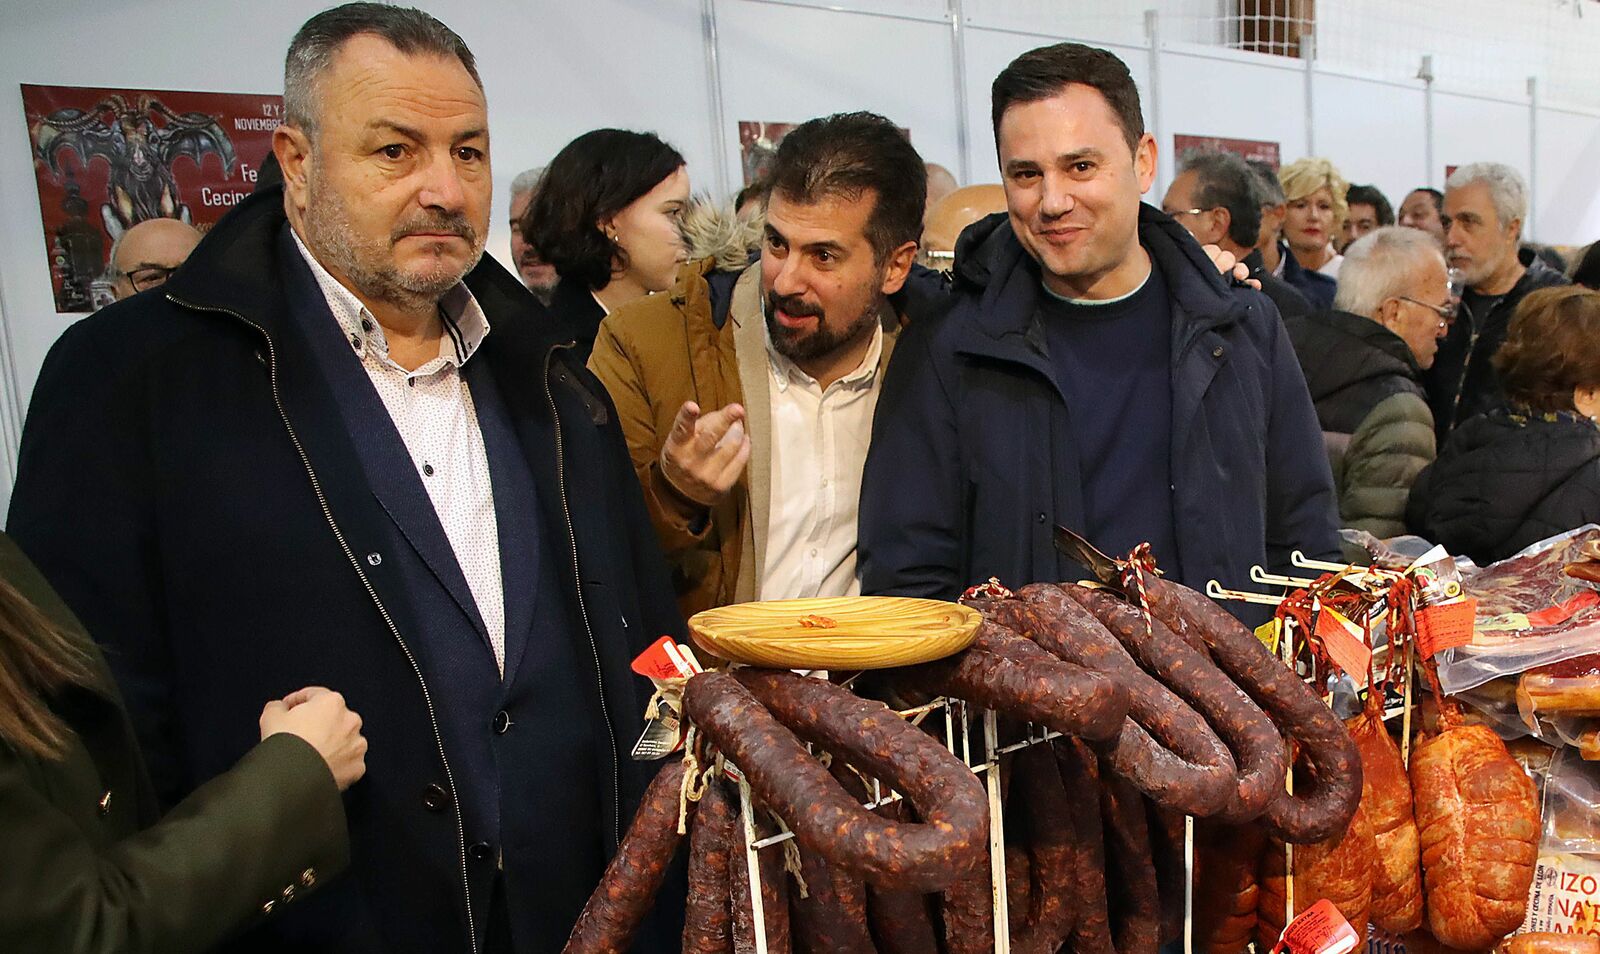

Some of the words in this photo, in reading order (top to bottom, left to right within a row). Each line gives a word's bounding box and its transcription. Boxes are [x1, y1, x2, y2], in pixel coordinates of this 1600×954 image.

[262, 104, 272, 116] 12
[273, 104, 280, 117] Y
[202, 187, 252, 205] Cecin
[1533, 891, 1541, 911] CECINA
